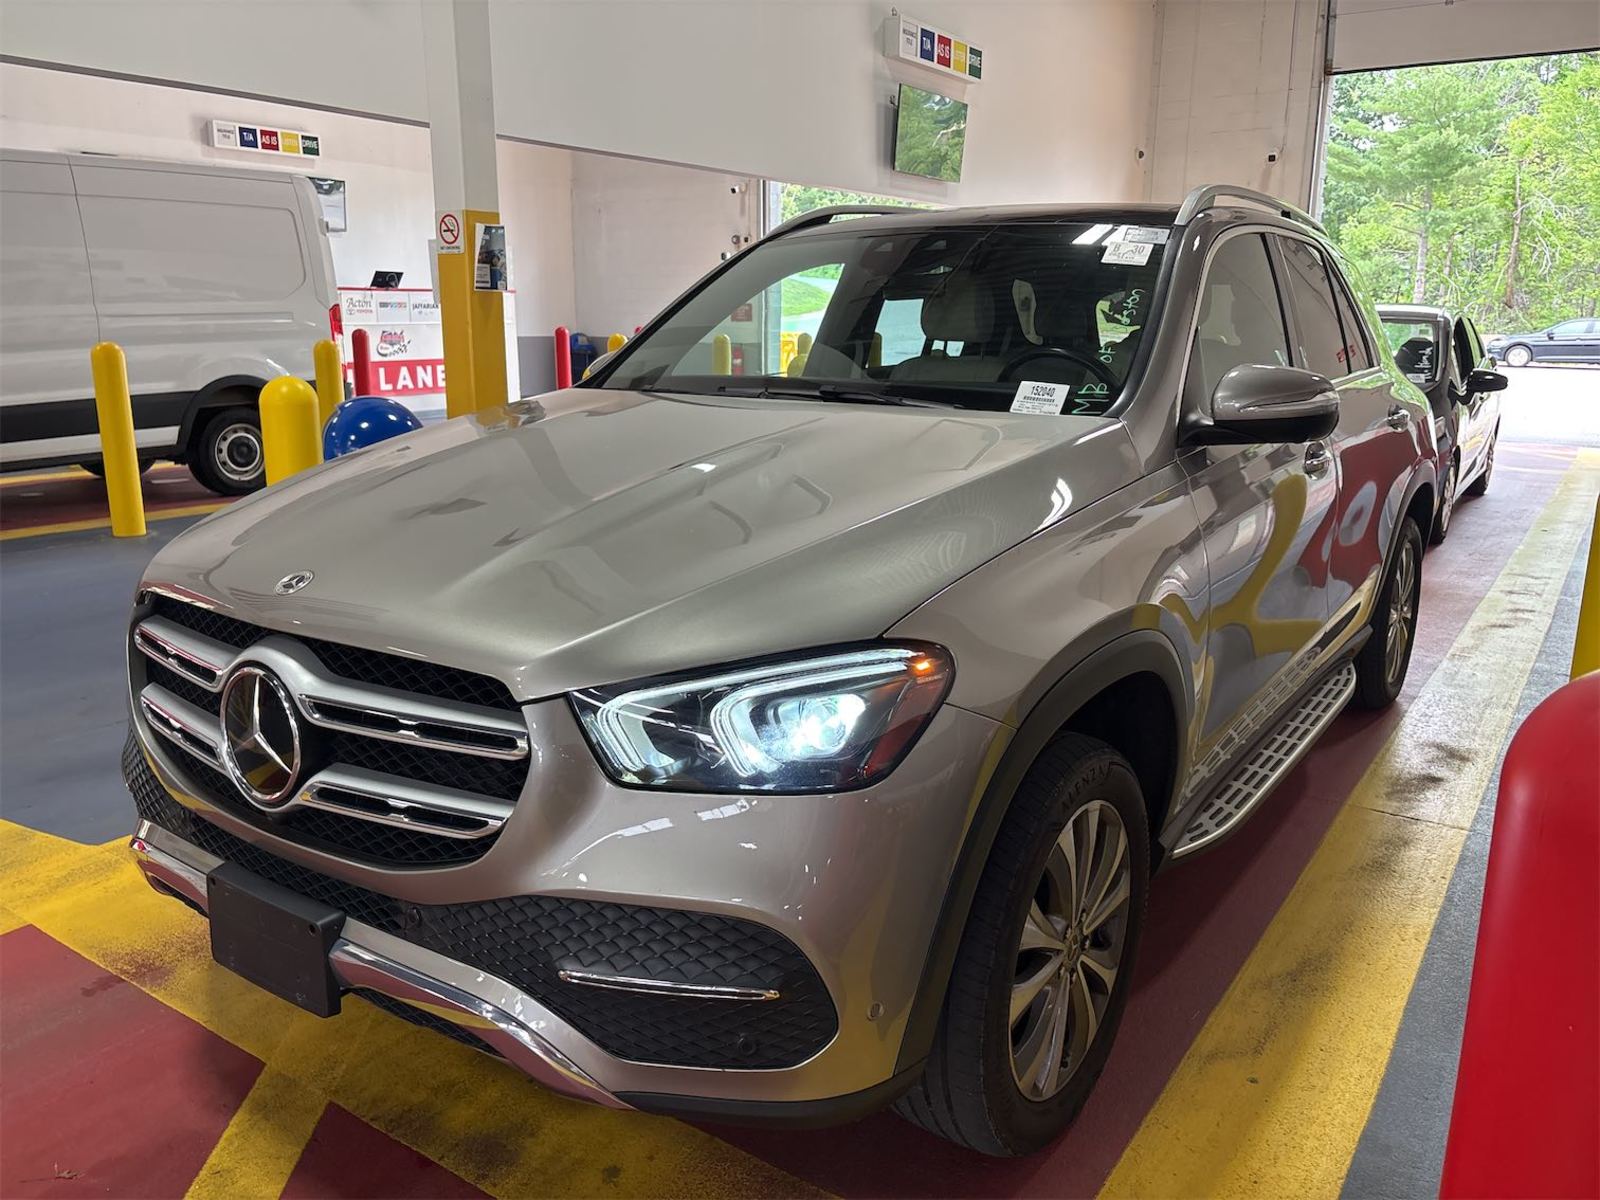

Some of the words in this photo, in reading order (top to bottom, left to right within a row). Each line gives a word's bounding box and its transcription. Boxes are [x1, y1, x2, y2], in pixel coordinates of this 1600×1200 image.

[922, 37, 931, 51] T/A
[243, 131, 254, 142] T/A
[261, 135, 270, 145] AS
[271, 136, 278, 145] IS
[301, 139, 318, 149] DRIVE
[1133, 244, 1146, 254] 30
[346, 297, 372, 308] Acton
[378, 365, 446, 391] LANE
[1031, 385, 1056, 398] 152040
